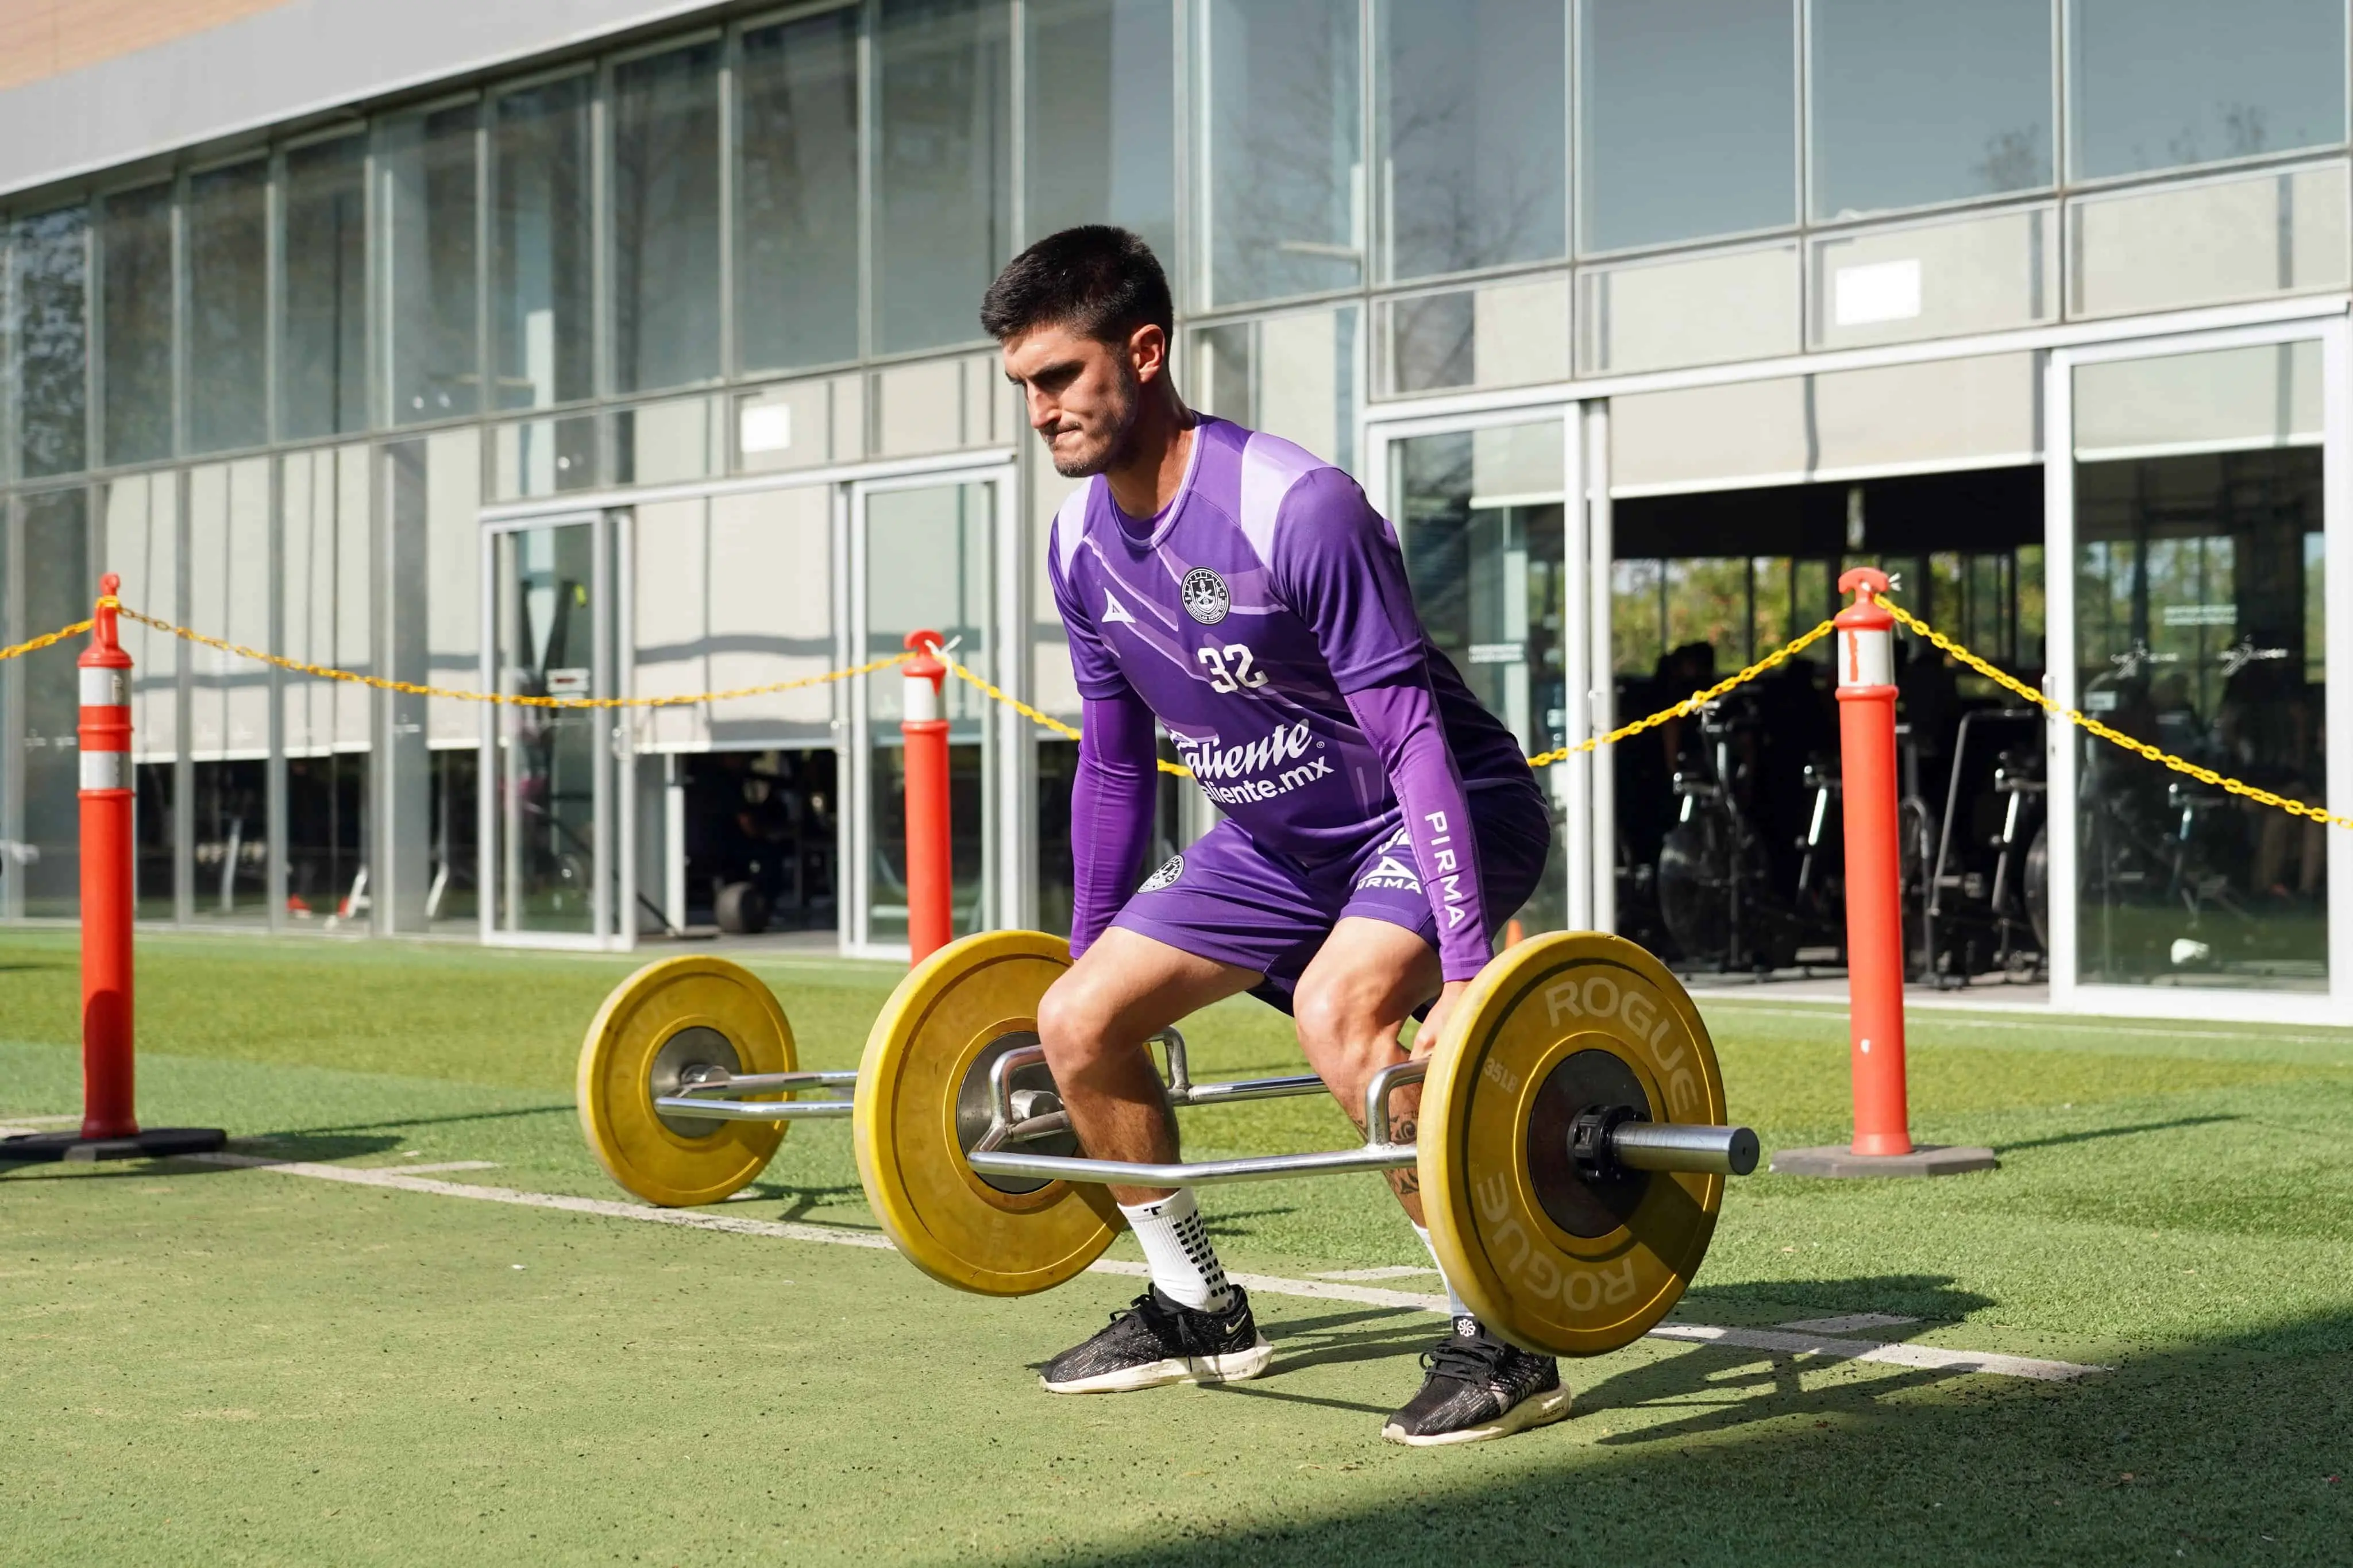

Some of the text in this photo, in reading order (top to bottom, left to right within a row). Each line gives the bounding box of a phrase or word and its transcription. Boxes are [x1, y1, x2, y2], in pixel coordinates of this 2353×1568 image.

[1198, 644, 1269, 693] 32
[1201, 756, 1334, 804] aliente.mx
[1355, 878, 1422, 894] IRMA
[1425, 811, 1465, 923] PIRMA
[1545, 978, 1699, 1115] ROGUE
[1484, 1057, 1518, 1094] 35LB
[1478, 1172, 1637, 1311] ROGUE
